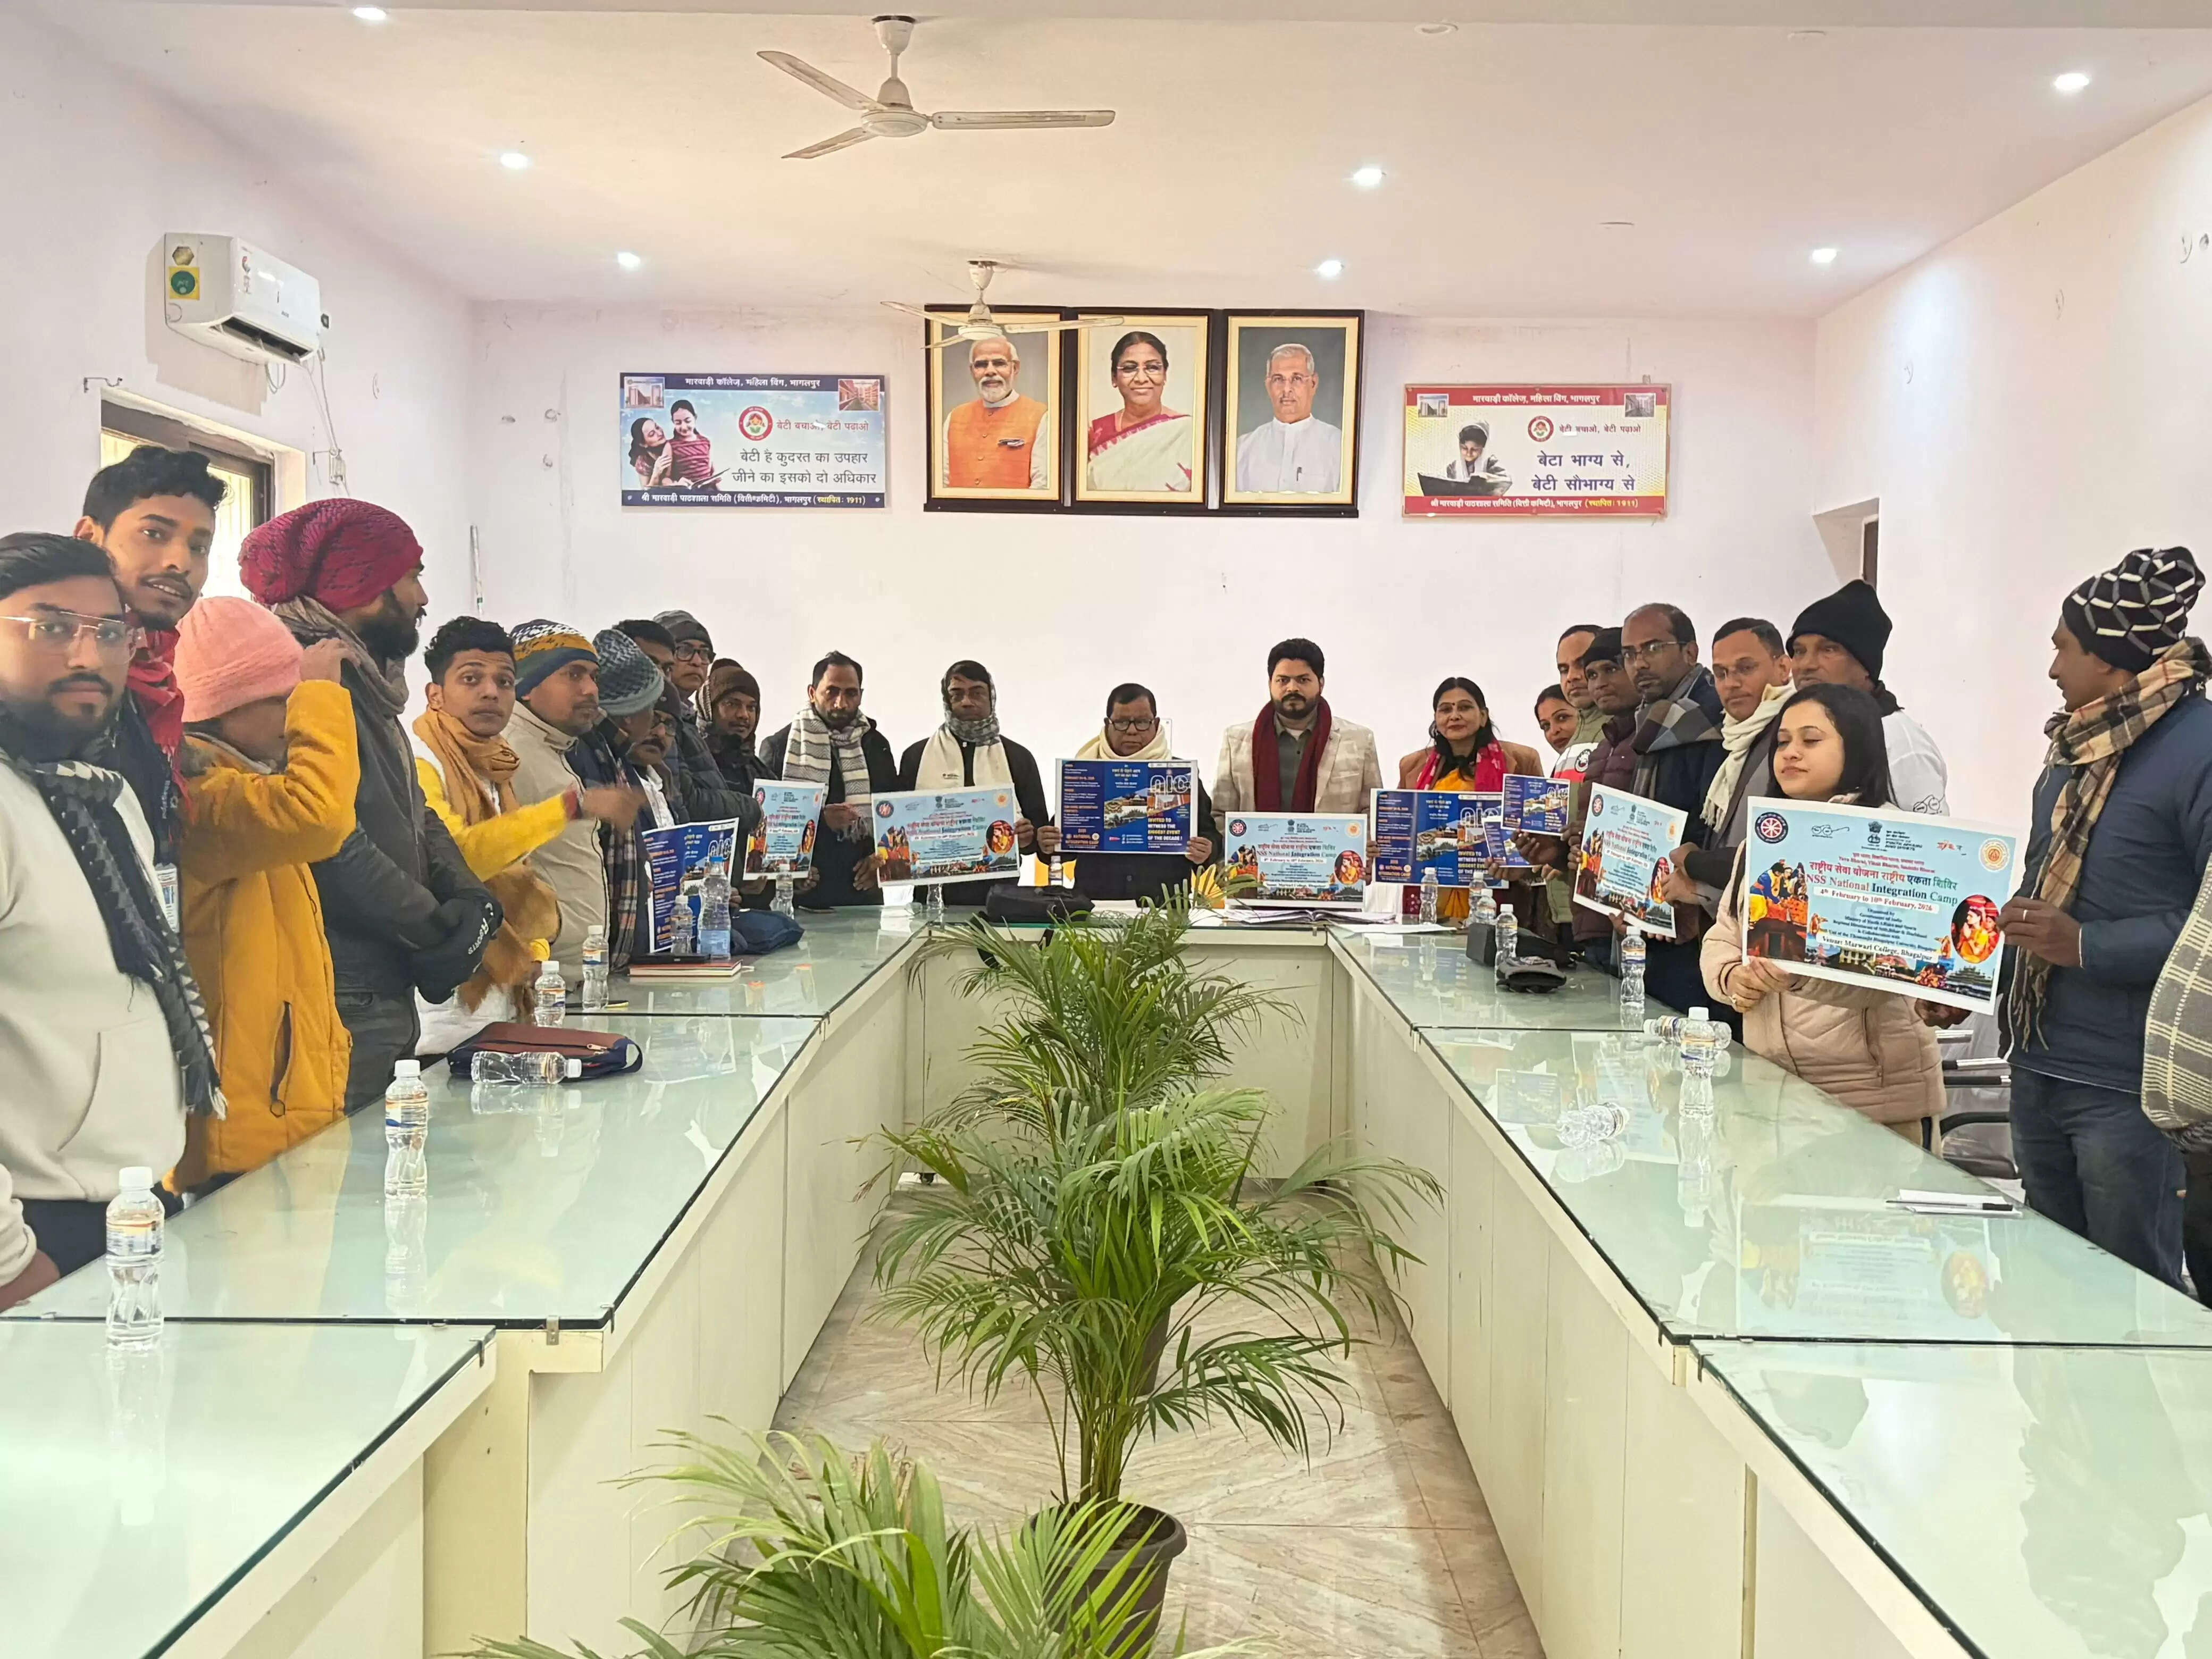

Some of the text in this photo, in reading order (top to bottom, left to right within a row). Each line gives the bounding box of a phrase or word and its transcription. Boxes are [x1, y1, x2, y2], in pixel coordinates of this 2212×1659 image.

[745, 376, 768, 387] महिला
[790, 378, 820, 389] भागलपुर
[1530, 393, 1552, 403] महिला
[1570, 395, 1601, 404] भागलपुर
[1559, 424, 1572, 432] बेटी
[1576, 424, 1600, 433] बचाओ,
[1604, 424, 1616, 432] बेटी
[740, 448, 868, 467] बेटी है कुदरत का उपहार
[1537, 450, 1563, 467] बेटा
[1571, 454, 1604, 467] भाग्य
[732, 469, 877, 484] जीने का इसको दो अधिकार
[1531, 474, 1636, 491] बेटी सौभाग्य से
[641, 492, 650, 502] श्री
[710, 493, 732, 502] समिति
[784, 496, 811, 505] भागलपुर
[847, 496, 866, 505] 1911)
[1556, 500, 1582, 509] भागलपुर
[1834, 864, 1851, 875] सेवा
[1853, 866, 1879, 879] योजना
[1907, 874, 1931, 886] एकता
[1933, 876, 1958, 890] शिविर
[1806, 874, 1958, 907] NSS National Integration Camp
[1832, 890, 1862, 902] February
[1845, 940, 1873, 951] Marwari
[1900, 949, 1932, 961] Bhagalpur
